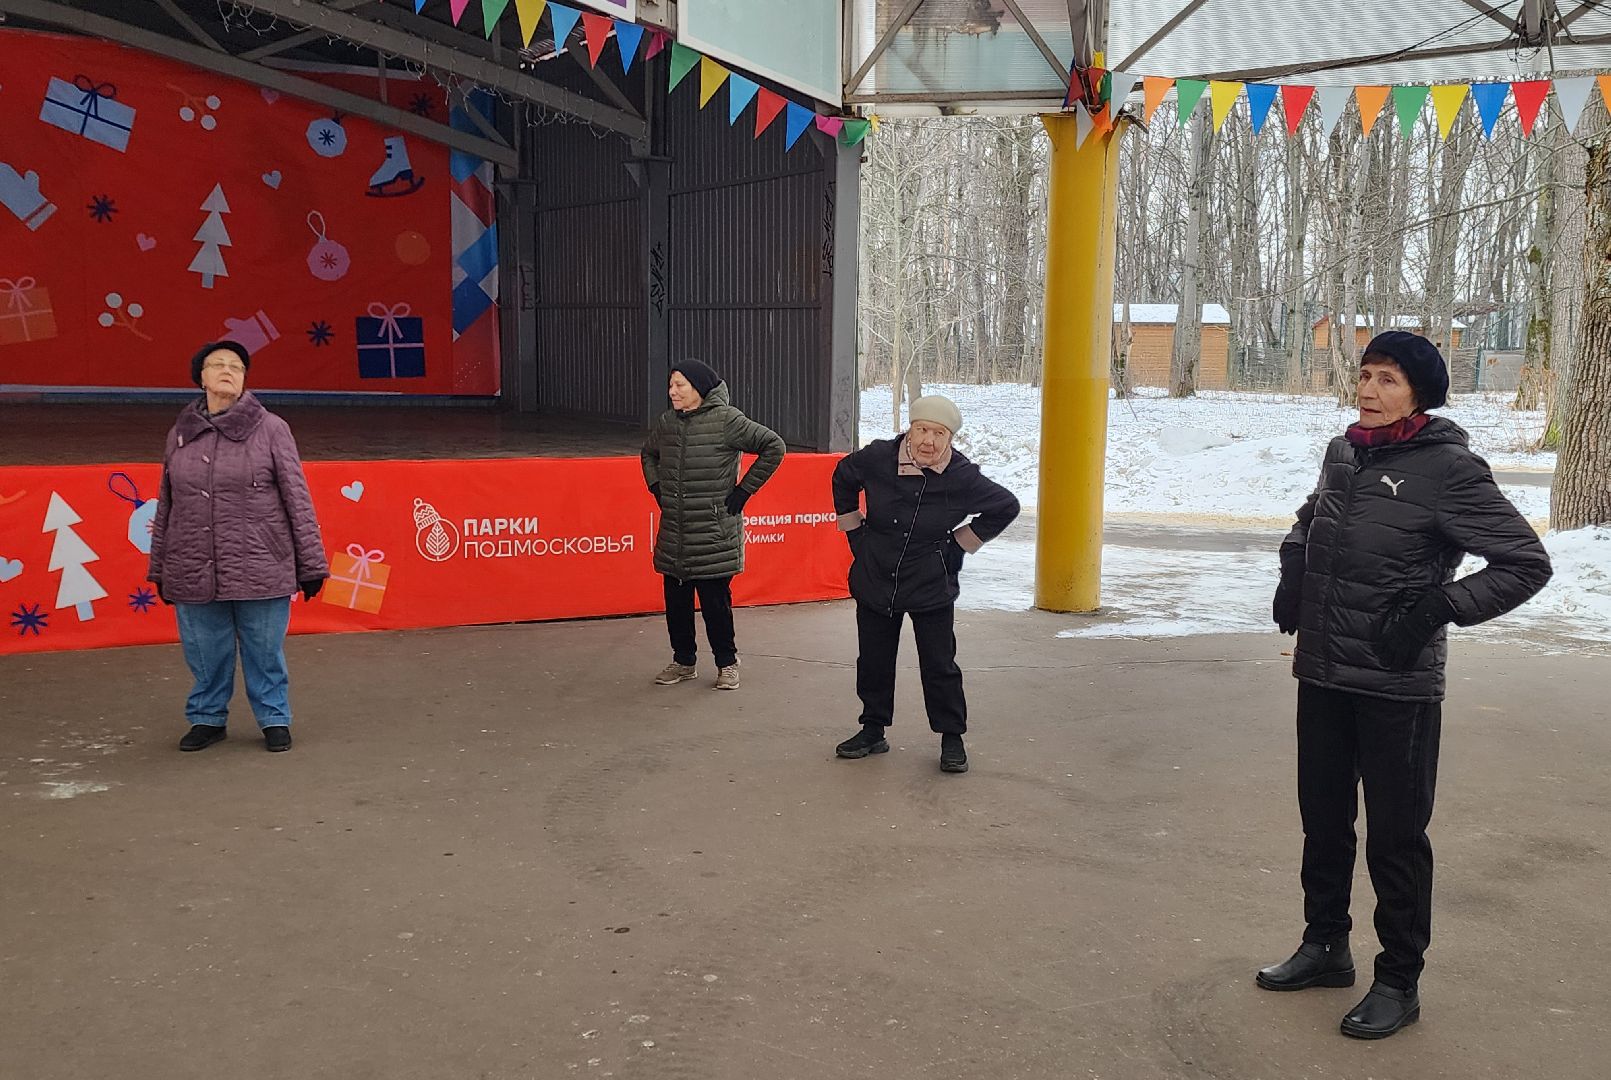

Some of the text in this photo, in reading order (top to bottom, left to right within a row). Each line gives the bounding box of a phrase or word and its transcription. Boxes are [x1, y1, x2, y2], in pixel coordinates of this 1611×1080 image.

[463, 517, 538, 536] ПАРКИ
[743, 512, 837, 527] рекция парко
[744, 530, 785, 544] Химки
[464, 535, 634, 558] ПОДМОСКОВЬЯ
